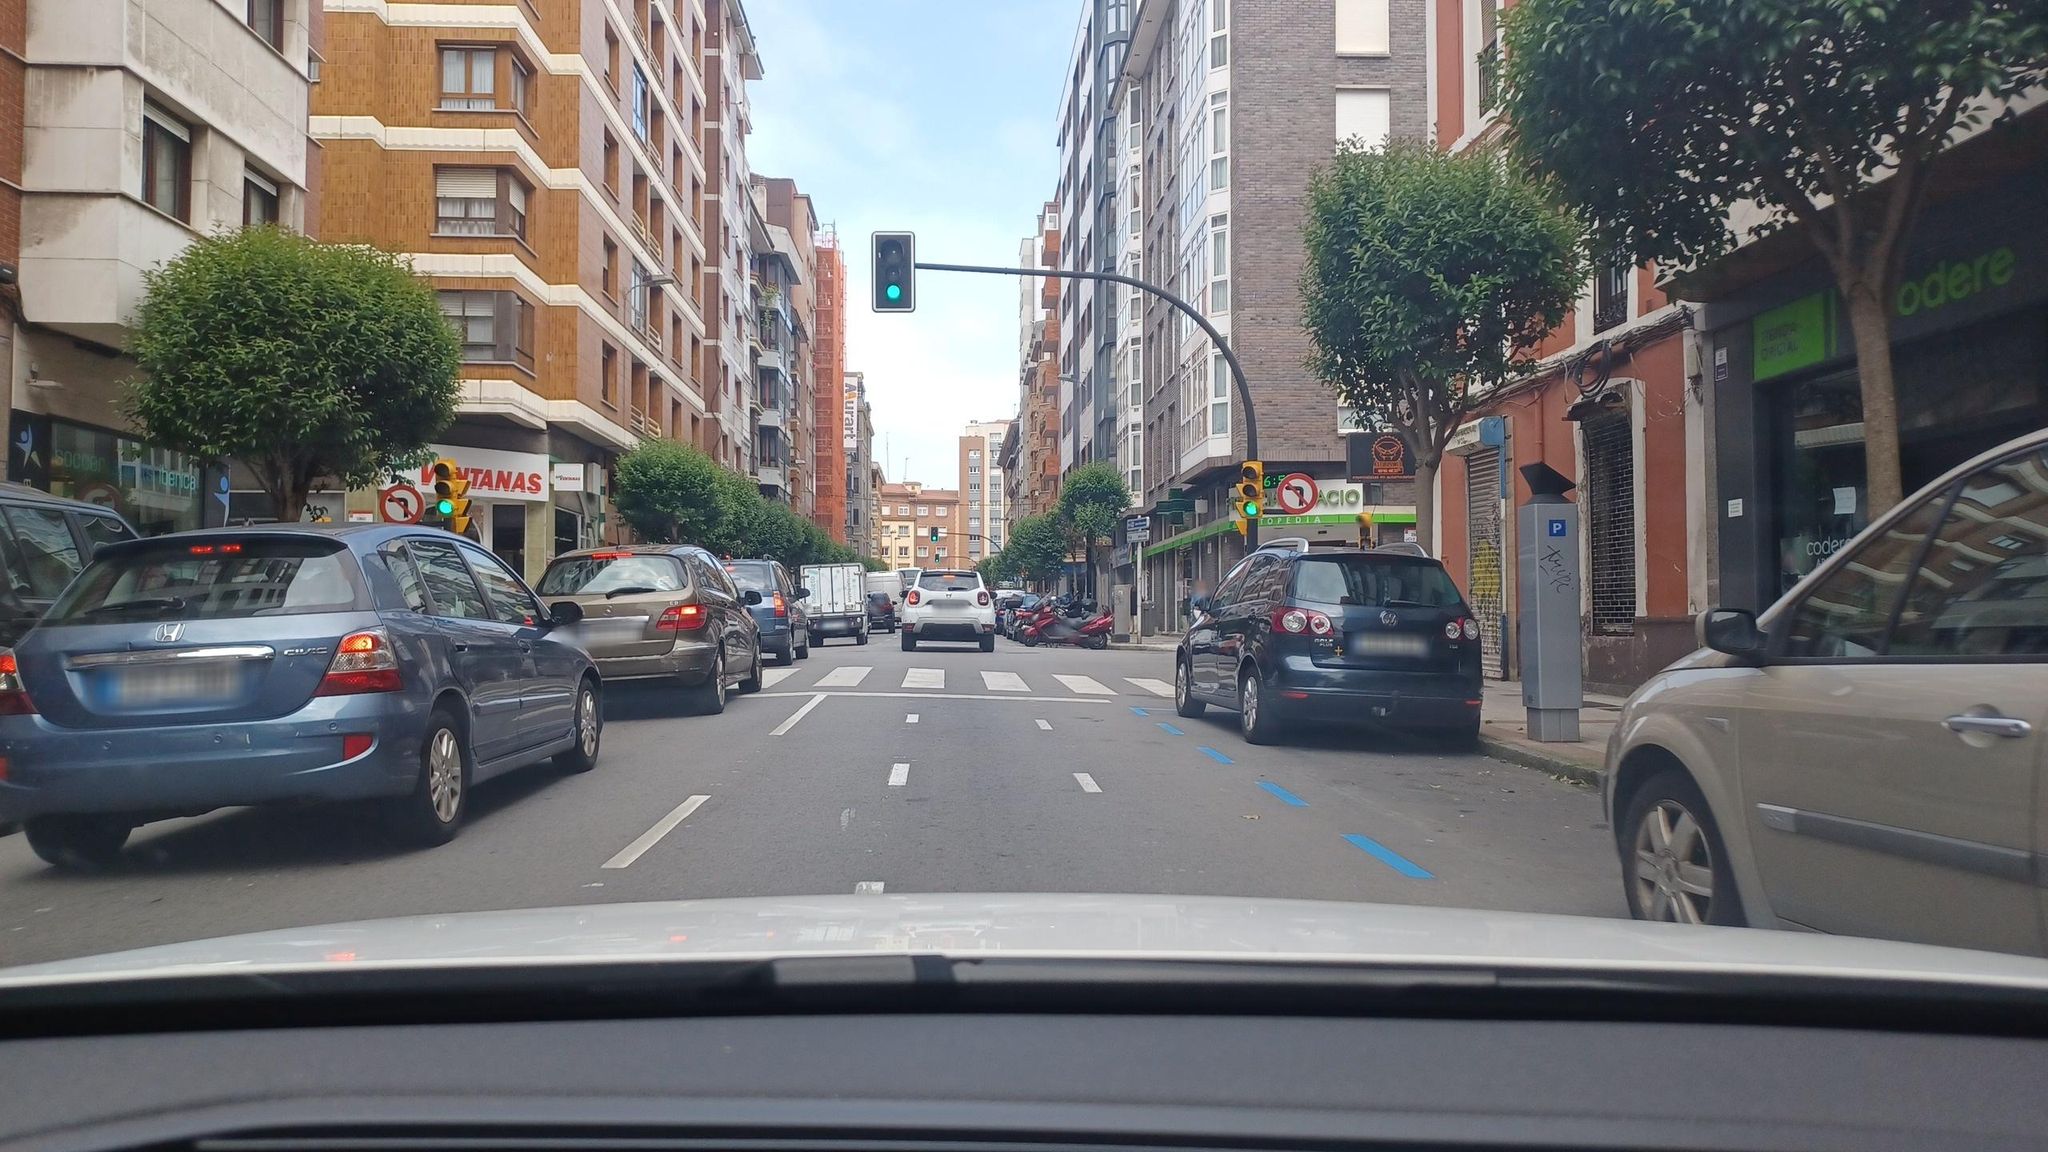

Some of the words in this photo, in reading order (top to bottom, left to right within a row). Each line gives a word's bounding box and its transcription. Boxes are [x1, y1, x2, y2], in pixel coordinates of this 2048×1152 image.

[1897, 247, 2016, 316] odere
[421, 463, 542, 495] VNTANAS
[1260, 516, 1321, 526] TOPEDIA
